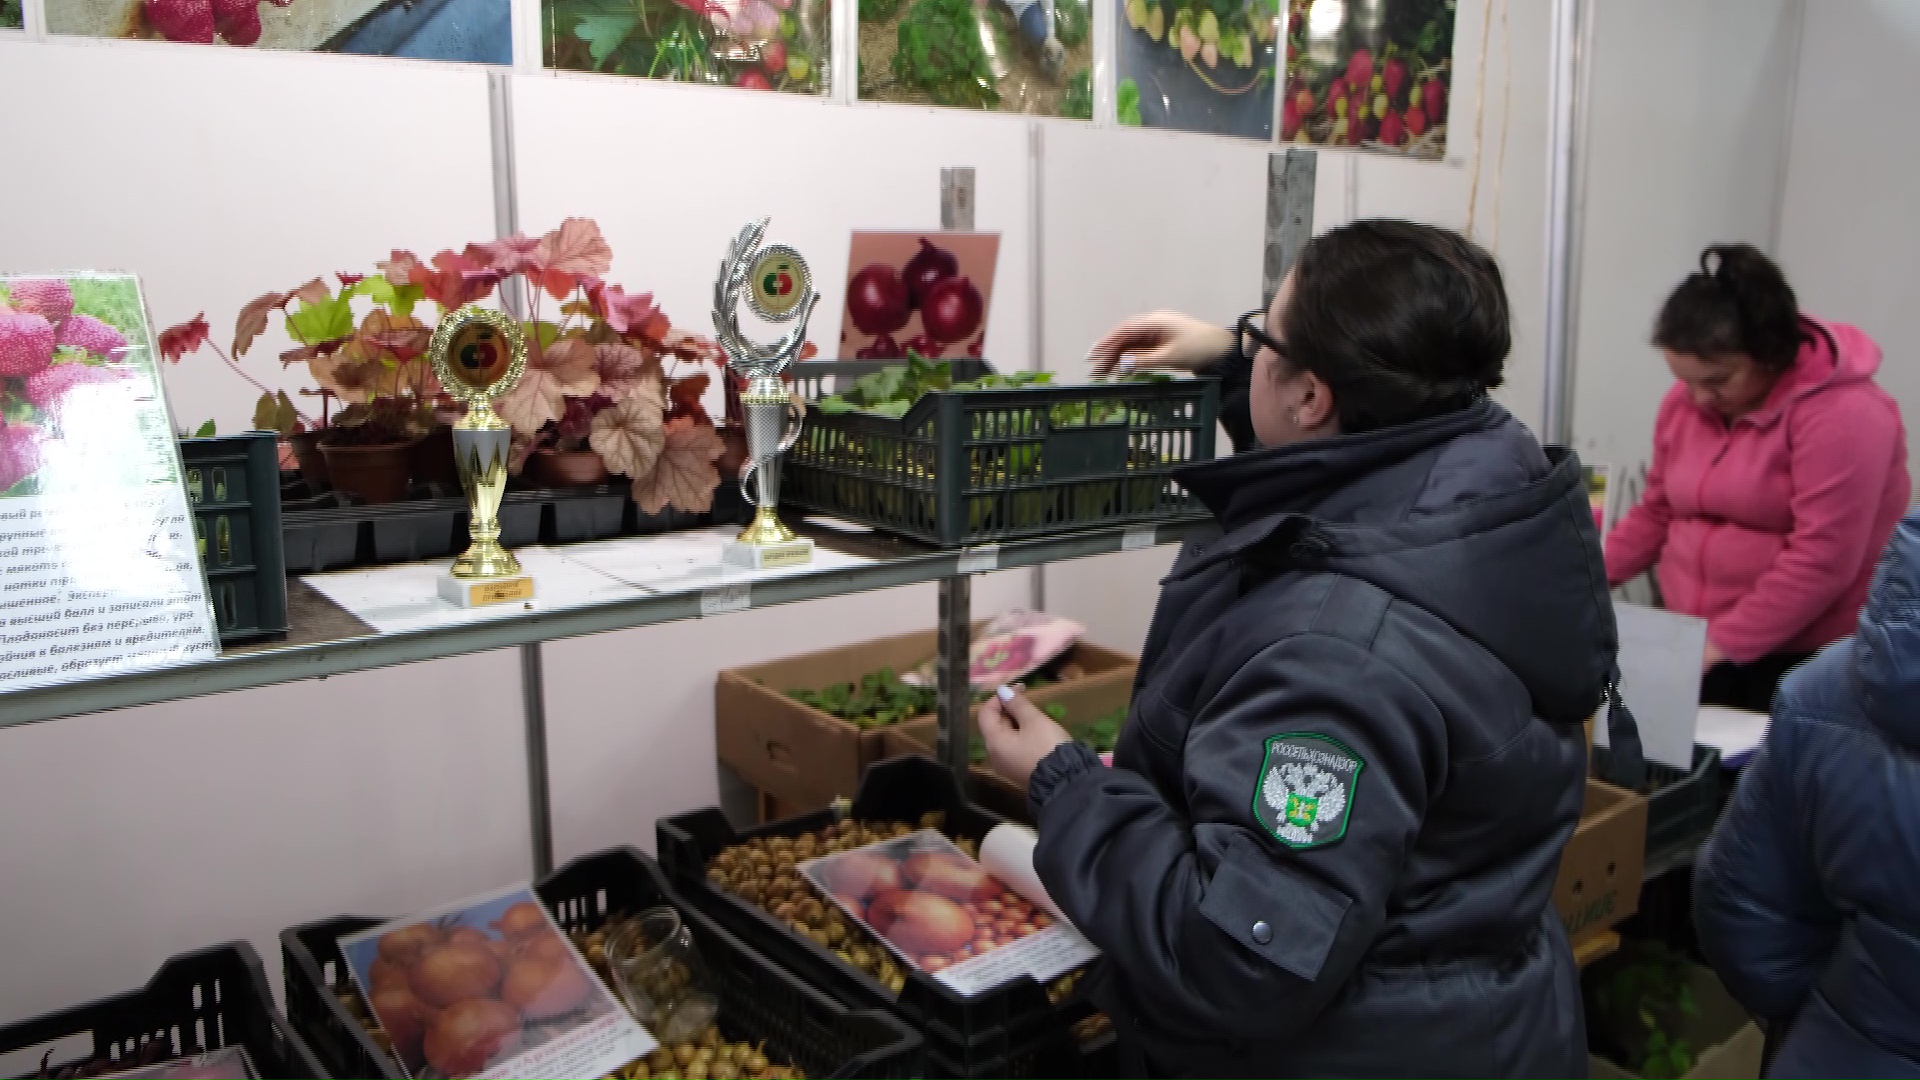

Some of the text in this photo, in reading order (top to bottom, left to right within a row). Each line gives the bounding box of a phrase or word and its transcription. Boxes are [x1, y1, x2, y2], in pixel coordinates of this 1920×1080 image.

[6, 563, 57, 575] мякоть
[4, 580, 46, 592] нотки
[484, 582, 520, 593] НАРОДНОЕ
[482, 591, 522, 602] ПРИАНИЕ
[10, 611, 61, 627] высший
[64, 608, 94, 619] балл
[98, 606, 105, 614] и
[109, 600, 163, 614] записали
[82, 623, 103, 634] без
[39, 650, 46, 658] к
[50, 640, 111, 656] болезням
[115, 638, 122, 646] и
[125, 627, 205, 646] вредителям.
[1270, 742, 1358, 773] РОССЕЛЬХОЗНАДЗОР
